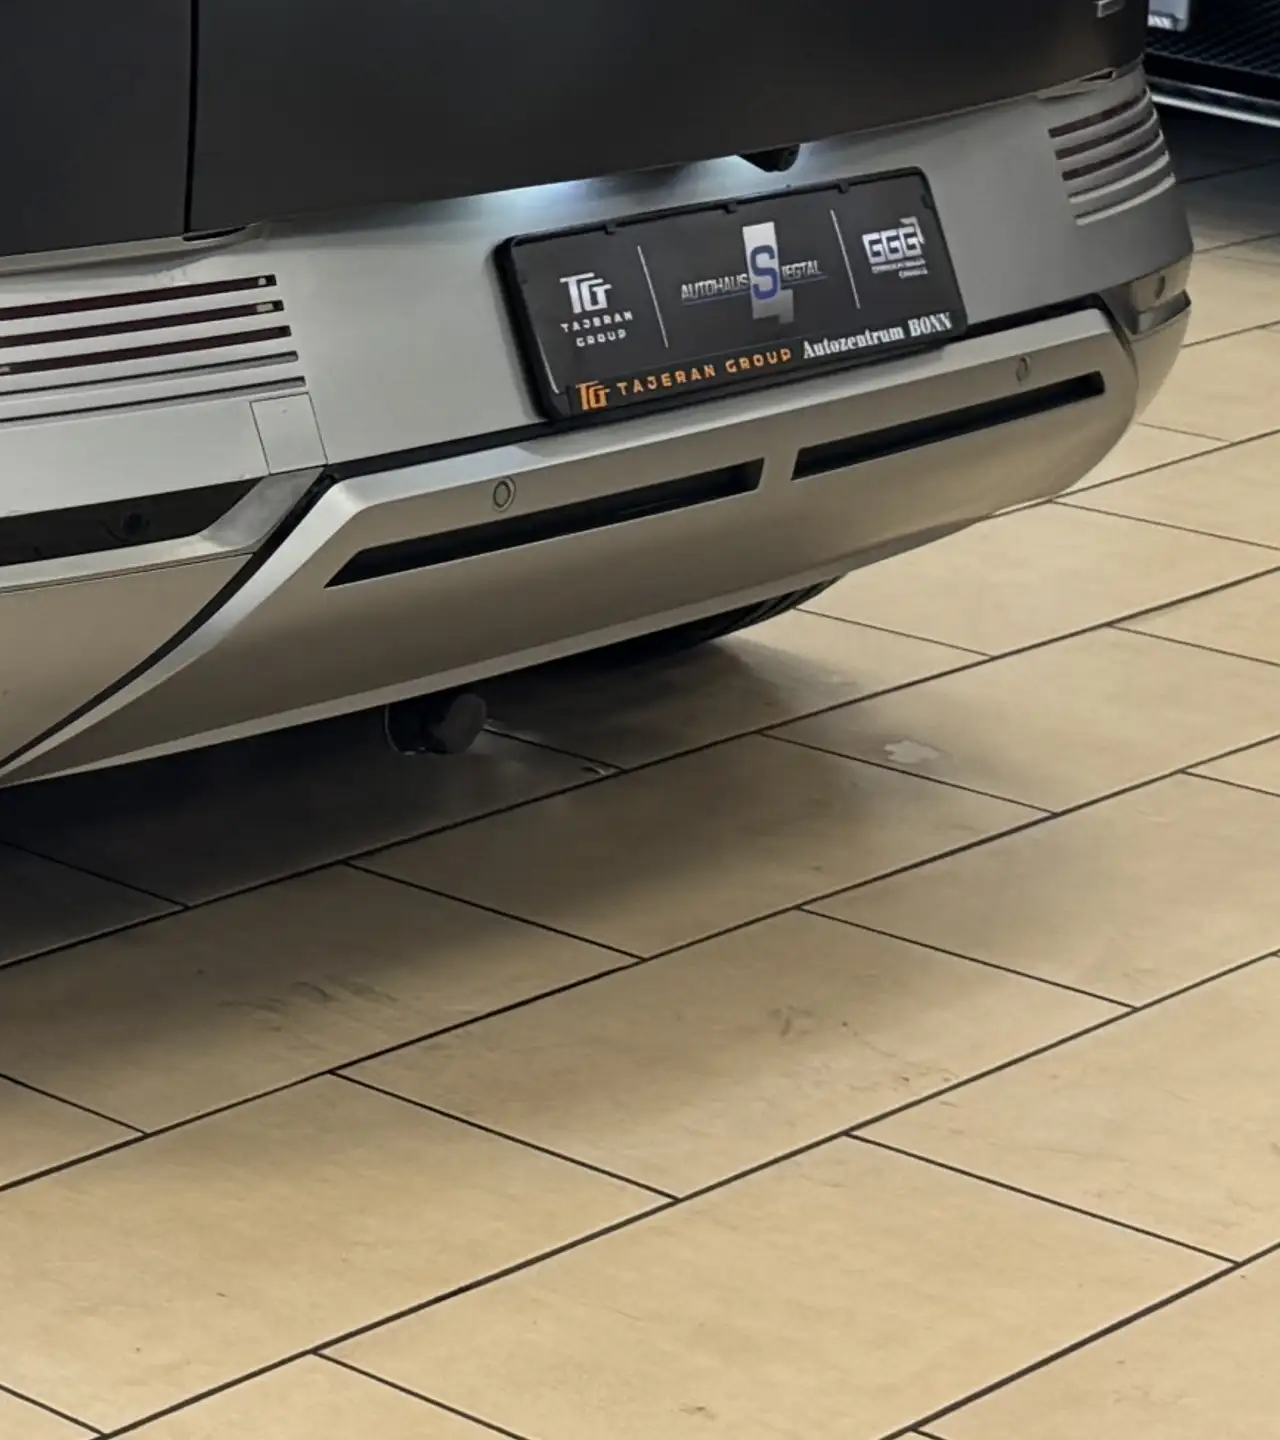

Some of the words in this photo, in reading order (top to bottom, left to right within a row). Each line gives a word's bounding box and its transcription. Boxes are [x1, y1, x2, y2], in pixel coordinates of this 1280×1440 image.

[680, 273, 750, 300] AUTOHAUS
[560, 310, 634, 334] TAJERAN
[803, 326, 906, 360] Autozentrum
[907, 311, 954, 338] BONN
[576, 328, 628, 348] GROUP
[616, 364, 717, 397] TAJERAN
[724, 348, 793, 374] GROUP
